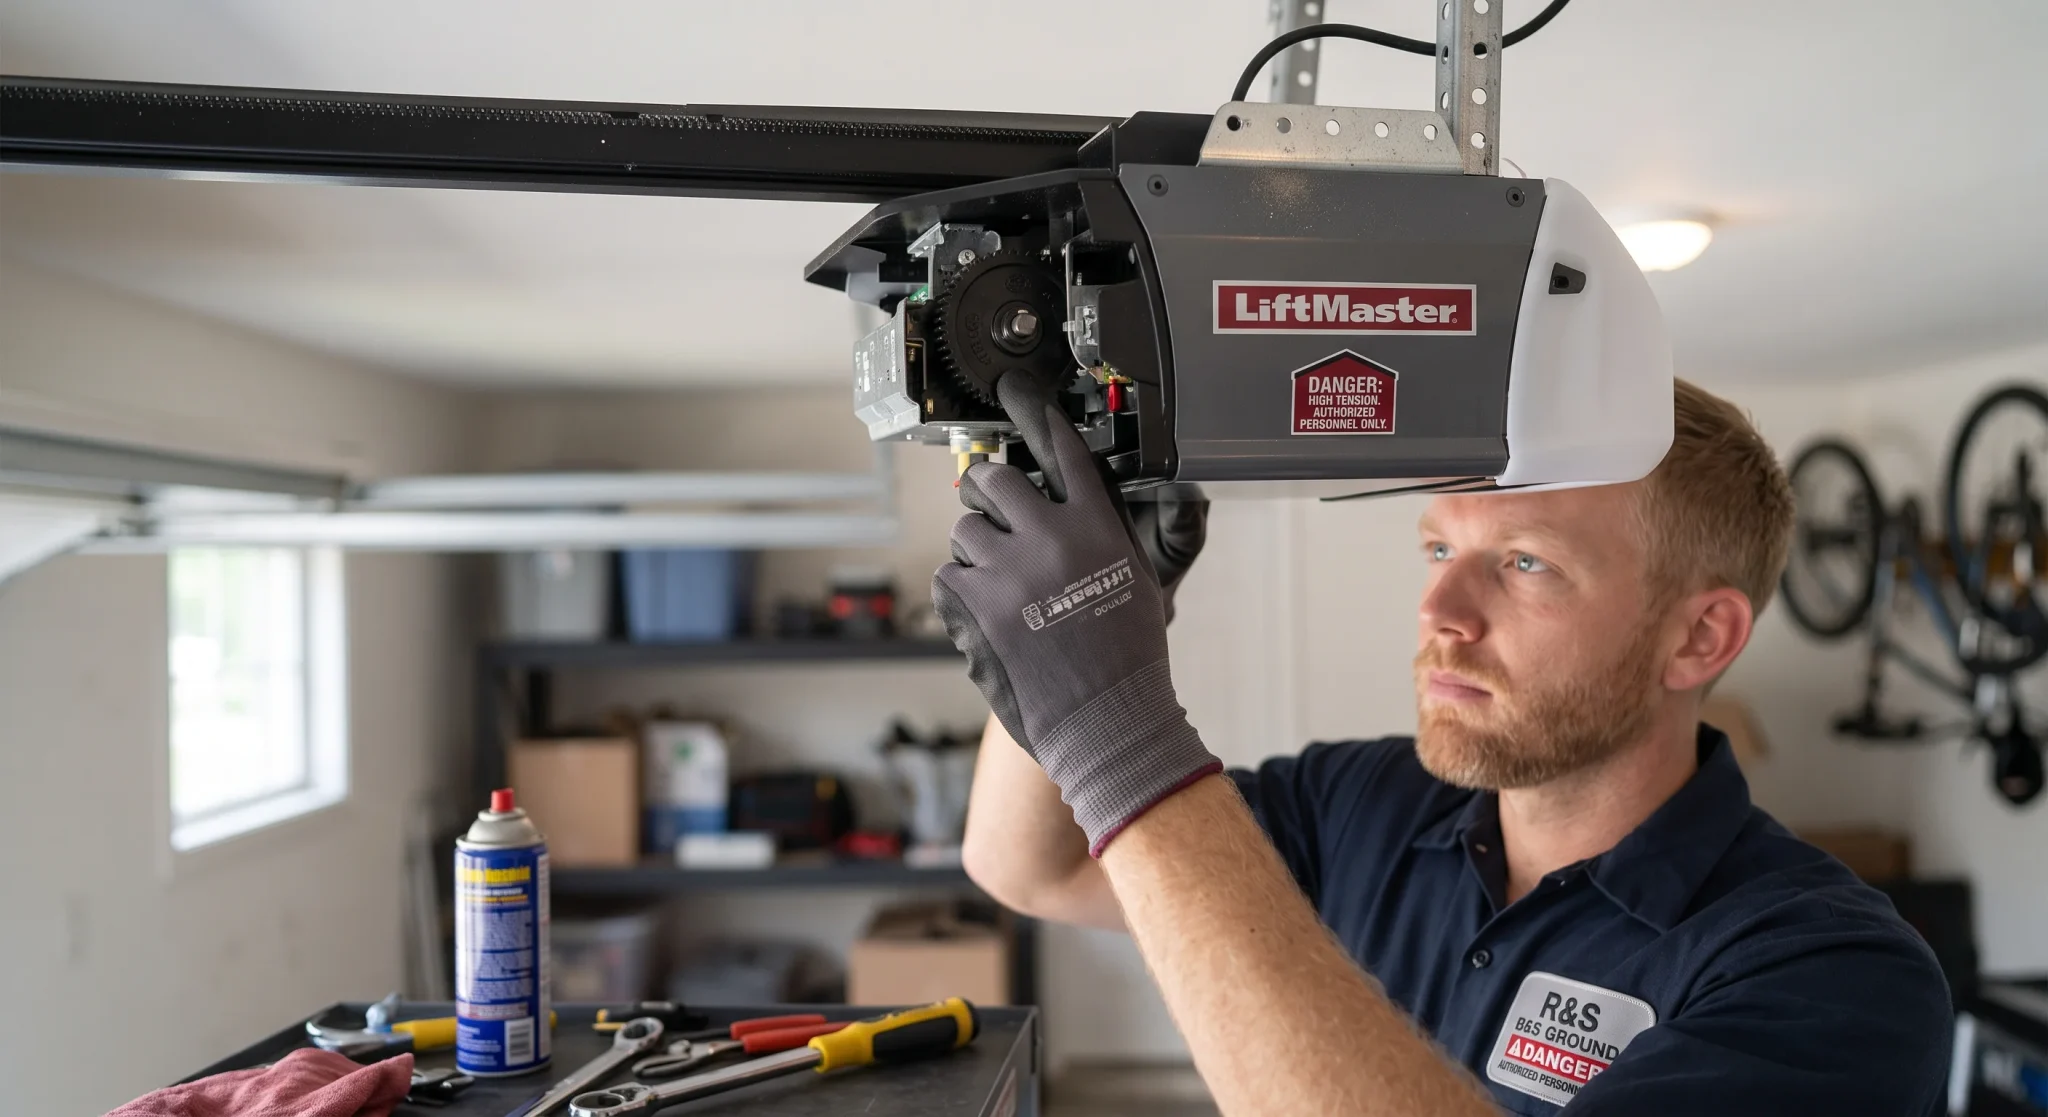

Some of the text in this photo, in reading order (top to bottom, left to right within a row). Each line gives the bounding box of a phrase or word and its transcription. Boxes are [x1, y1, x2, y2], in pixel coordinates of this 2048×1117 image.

[1308, 376, 1383, 394] DANGER:
[1308, 395, 1381, 406] HIGH TENSION.
[1313, 407, 1376, 418] AUTHORIZED
[1300, 418, 1387, 430] PERSONNEL ONLY.
[1539, 991, 1601, 1033] R&S
[1515, 1017, 1620, 1061] B&S GROUND
